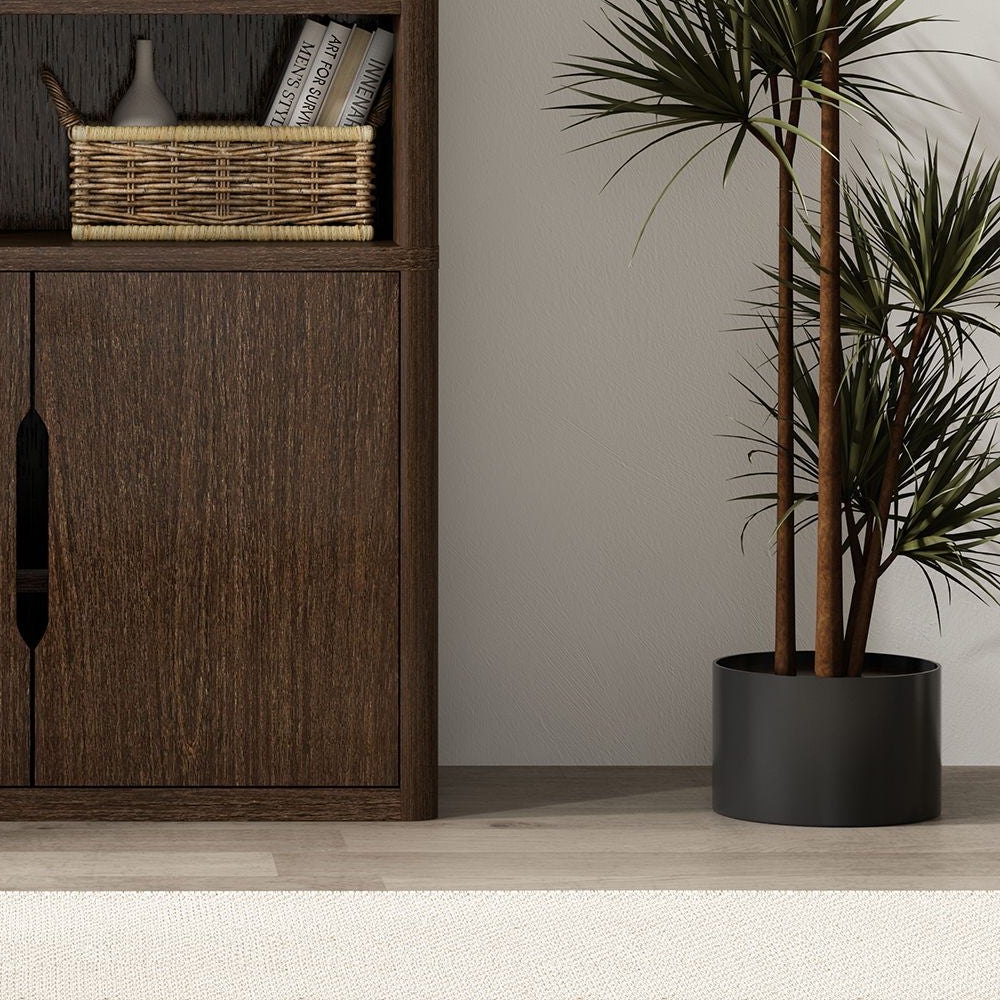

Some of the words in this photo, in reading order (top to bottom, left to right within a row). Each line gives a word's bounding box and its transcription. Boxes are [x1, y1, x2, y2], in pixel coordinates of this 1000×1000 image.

[325, 34, 342, 59] ART
[286, 40, 315, 89] MEN'S
[312, 60, 333, 86] FOR
